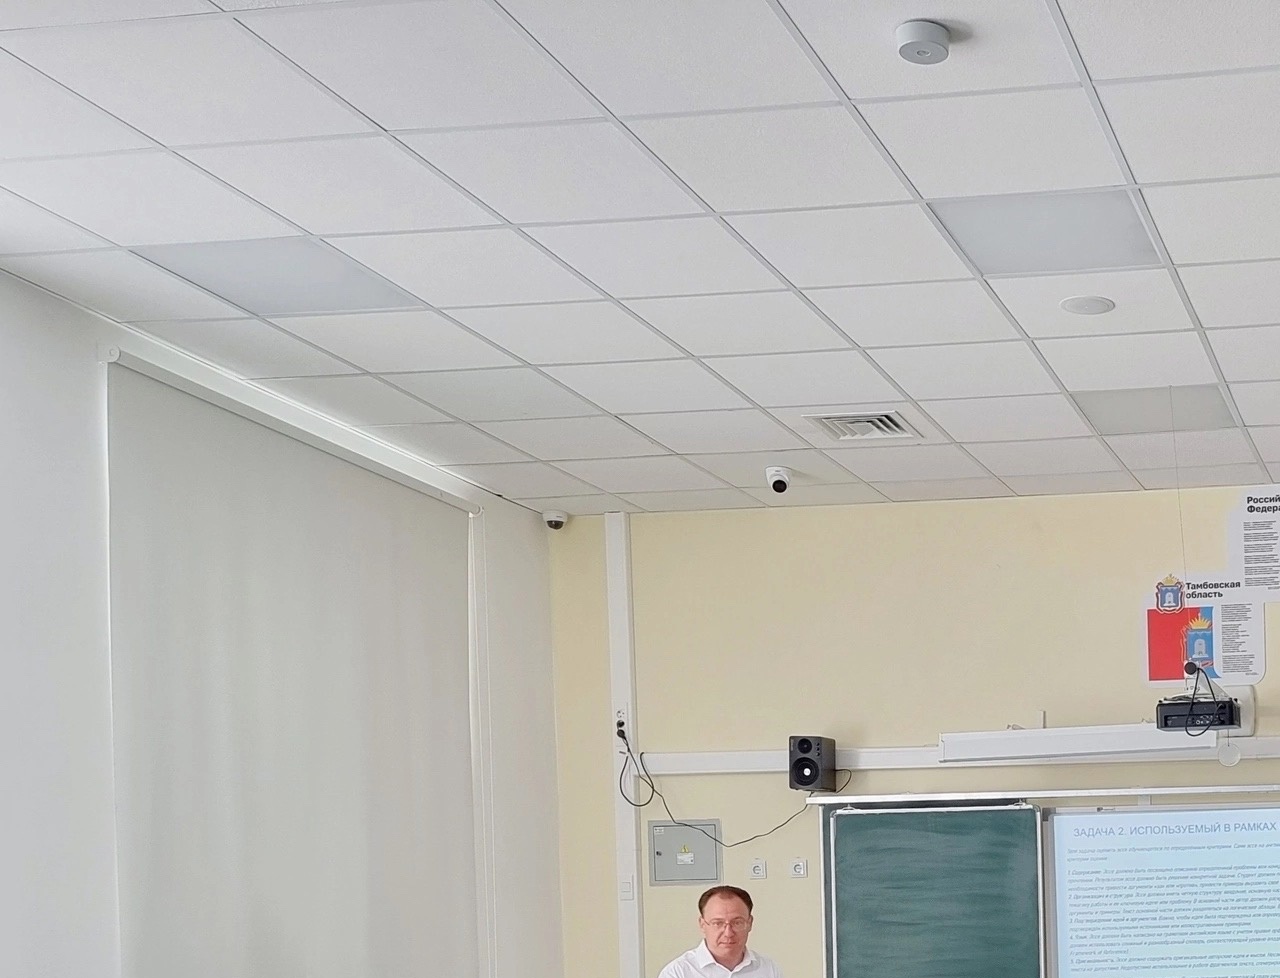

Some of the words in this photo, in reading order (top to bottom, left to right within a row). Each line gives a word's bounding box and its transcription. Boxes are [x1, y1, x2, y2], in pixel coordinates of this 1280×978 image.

[1186, 580, 1240, 590] Тамбовская
[1186, 590, 1223, 600] область
[1074, 827, 1116, 838] ЗАДАЧА
[1130, 822, 1221, 835] ИСПОЛЬЗУЕМЫЙ
[1224, 823, 1230, 832] В
[1234, 822, 1276, 832] РАМКАХ
